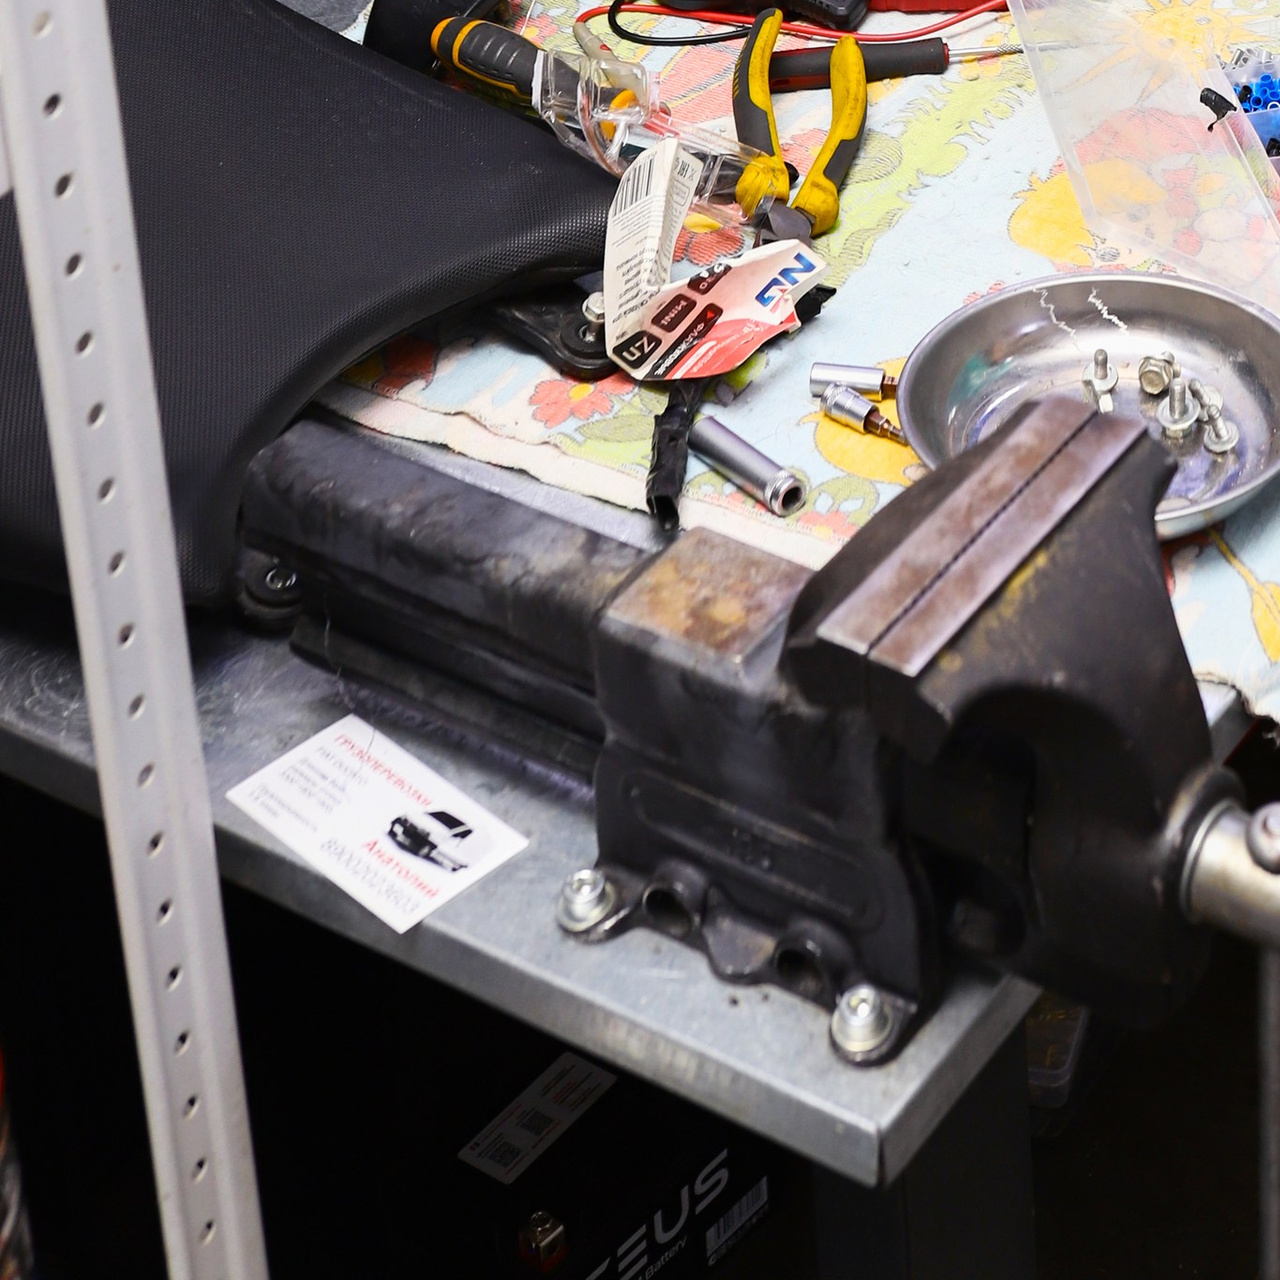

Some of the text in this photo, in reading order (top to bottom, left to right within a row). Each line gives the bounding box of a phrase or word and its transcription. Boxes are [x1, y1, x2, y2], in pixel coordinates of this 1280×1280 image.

[660, 299, 689, 326] MINI
[621, 329, 657, 362] Zn
[644, 1234, 689, 1280] Battery
